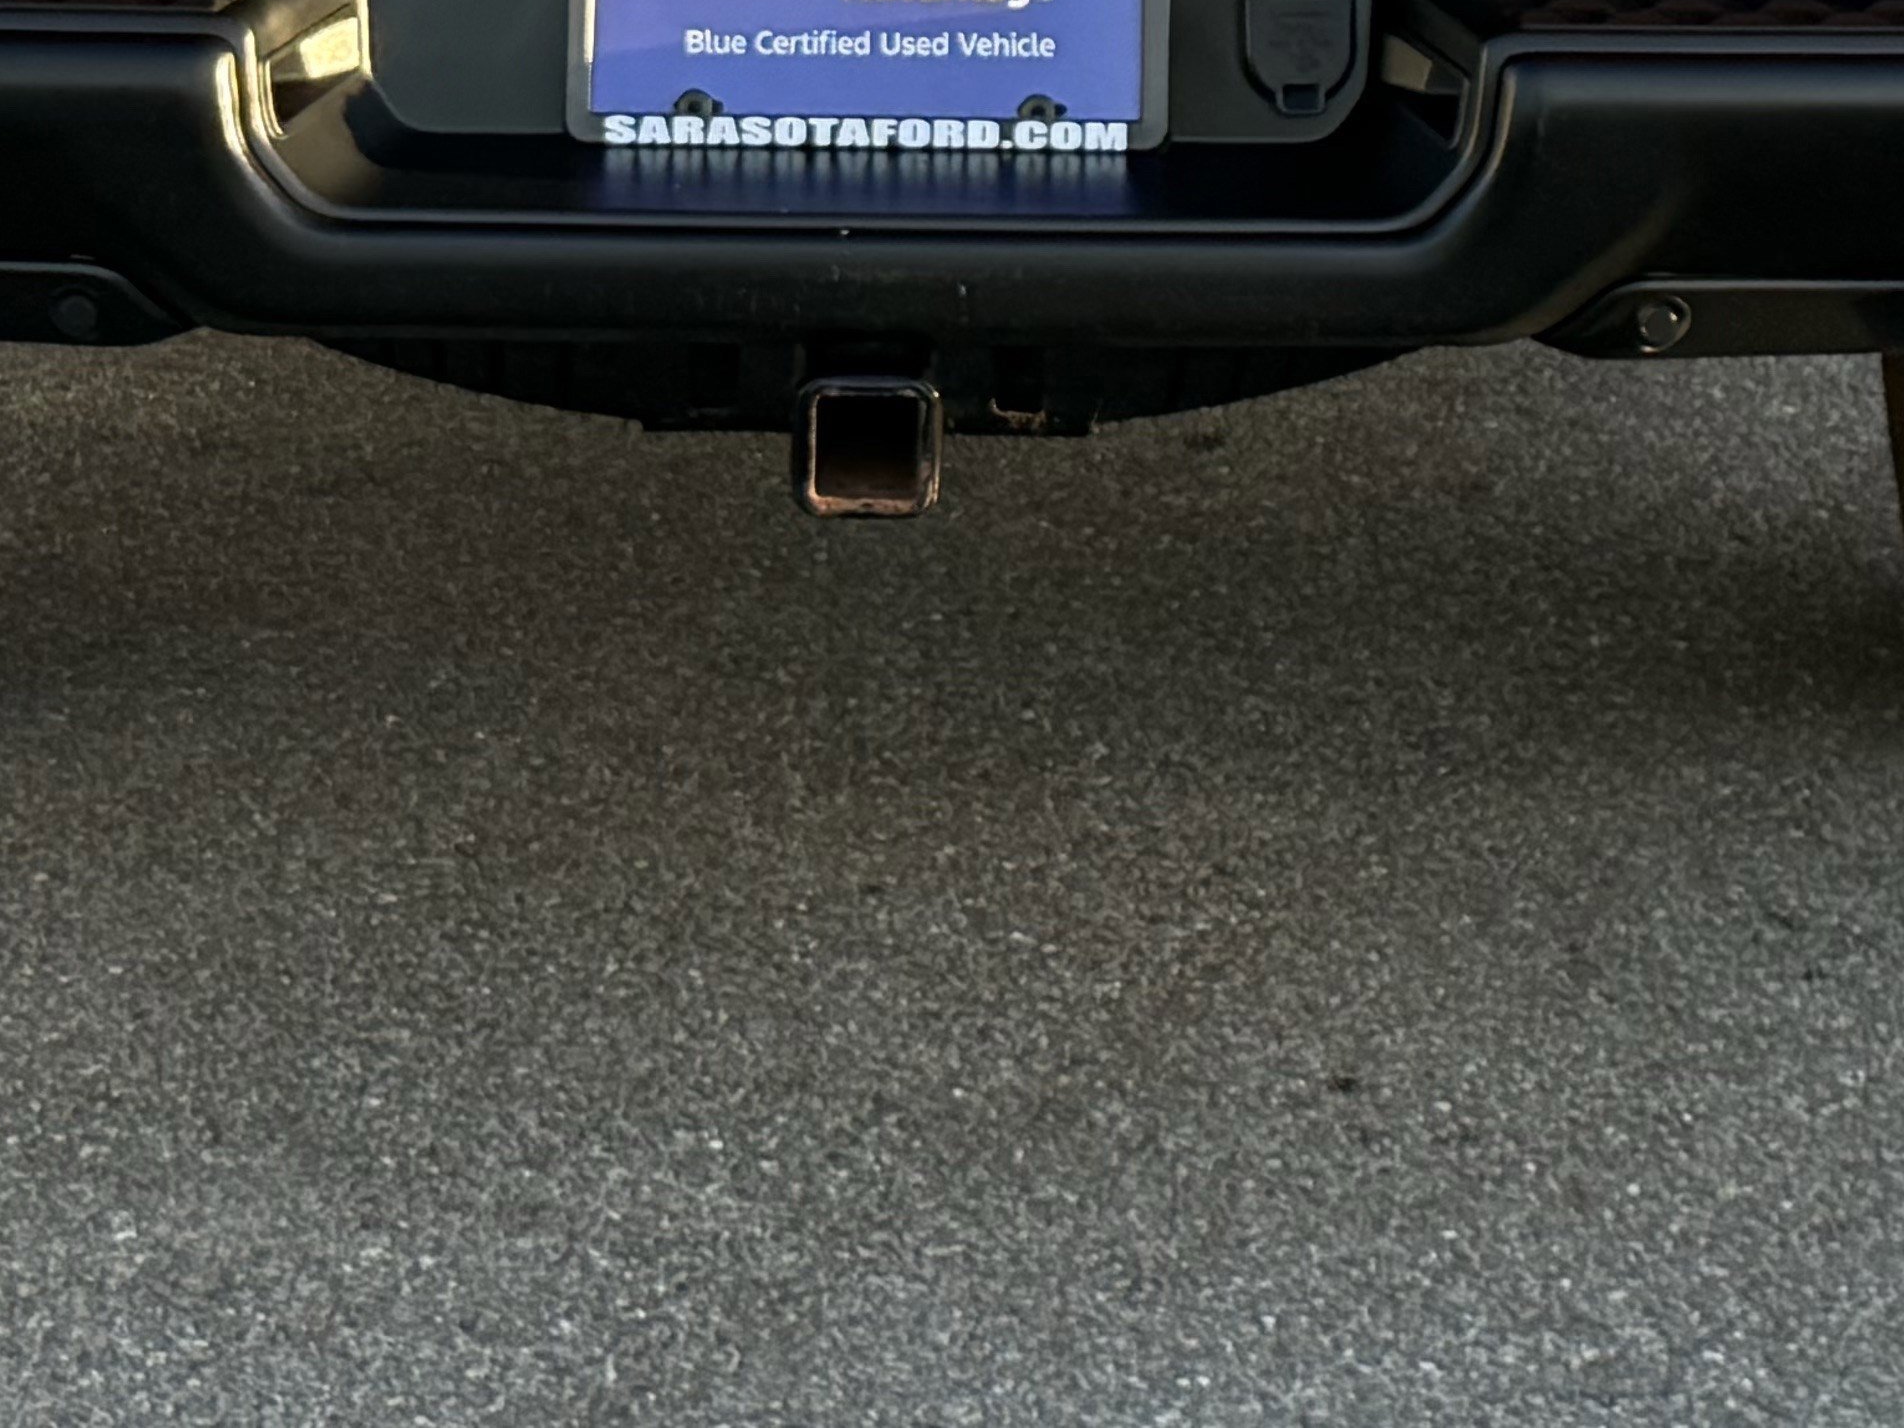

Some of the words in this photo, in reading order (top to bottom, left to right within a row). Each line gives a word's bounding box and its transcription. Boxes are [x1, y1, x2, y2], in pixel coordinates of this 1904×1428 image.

[685, 29, 747, 55] Blue
[754, 29, 871, 56] Certified
[879, 31, 949, 57] Used
[956, 31, 1057, 58] Vehicle
[603, 115, 1129, 152] SARASOTAFORD.COM
